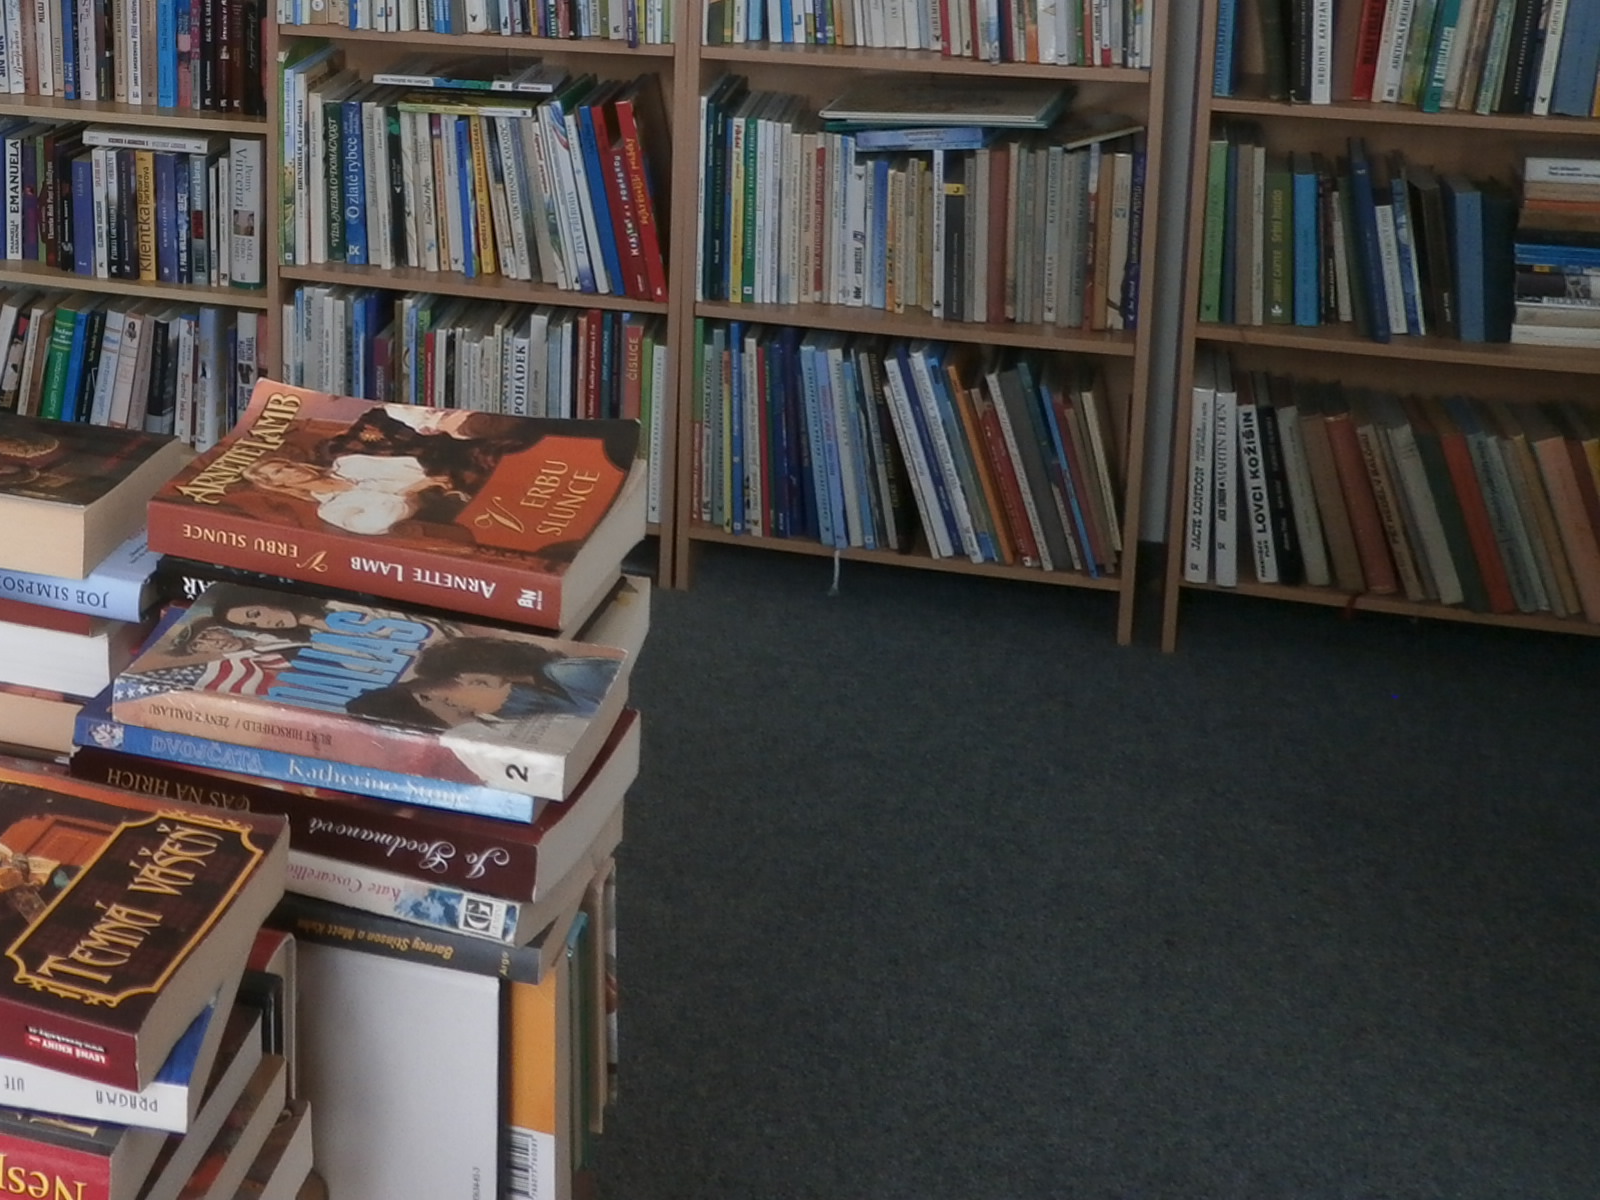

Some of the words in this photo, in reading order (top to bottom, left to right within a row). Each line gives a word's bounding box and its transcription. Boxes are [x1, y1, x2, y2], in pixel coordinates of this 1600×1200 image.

[521, 461, 568, 508] ERBU
[537, 472, 600, 537] SLUNCE
[182, 523, 247, 550] SLUNCE
[253, 538, 299, 558] ERBU
[350, 556, 404, 582] LAMB
[412, 568, 497, 599] ARNETTE
[76, 588, 110, 608] JOE
[260, 611, 432, 713] DALLAS
[506, 763, 529, 783] 2
[46, 899, 163, 986] TEMNÁ
